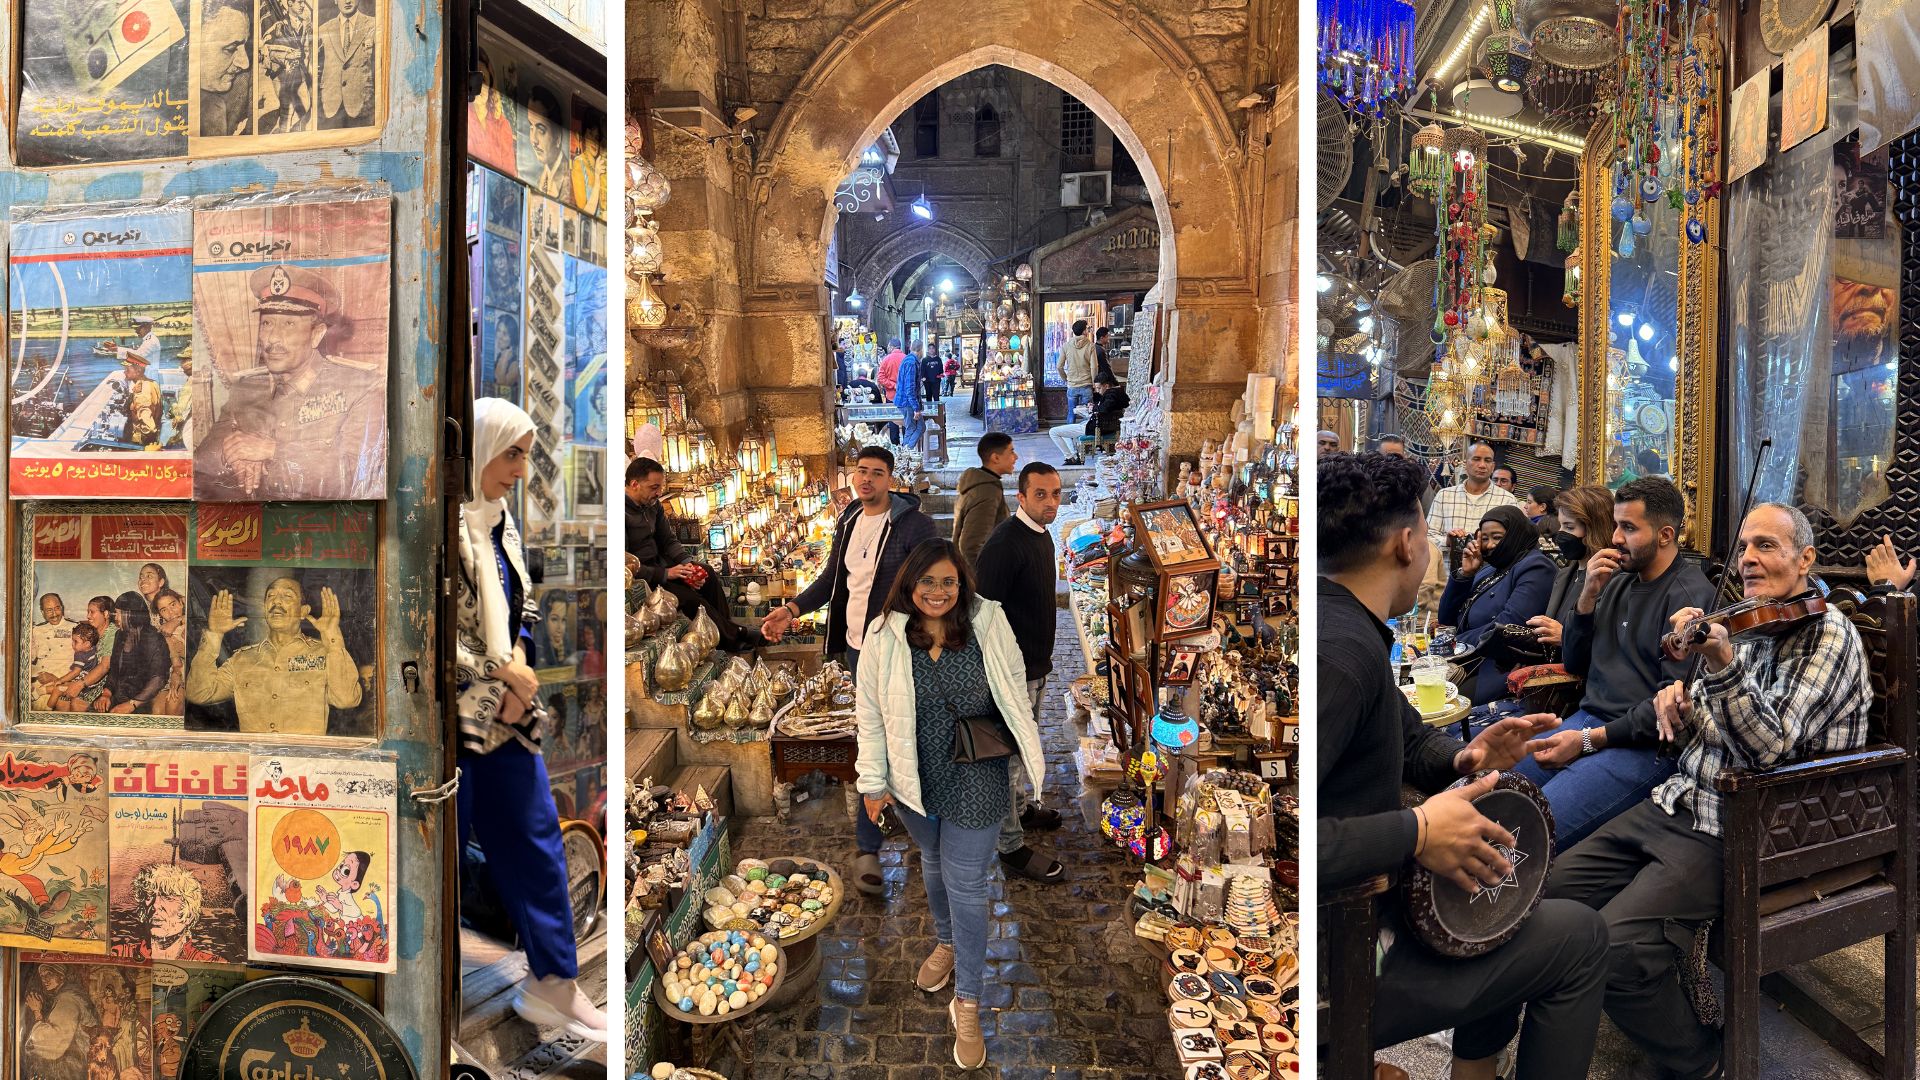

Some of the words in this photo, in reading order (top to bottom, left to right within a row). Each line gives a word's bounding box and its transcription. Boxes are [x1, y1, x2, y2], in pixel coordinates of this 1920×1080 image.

[32, 88, 188, 118] بالديموقراطية
[30, 118, 83, 136] كلمته
[81, 115, 143, 140] الشعب
[145, 115, 188, 137] يقول
[21, 461, 50, 479] يونيو
[51, 462, 63, 477] ٥
[66, 465, 86, 480] يوم
[124, 464, 154, 482] العبور
[147, 529, 179, 542] بطل
[100, 542, 140, 553] القناة
[1292, 727, 1299, 742] 8
[113, 763, 179, 793] تان
[1270, 761, 1278, 777] 5
[181, 764, 248, 795] تان
[256, 776, 329, 801] ماجد
[115, 807, 141, 821] لوجان
[141, 808, 168, 821] ميشيل
[283, 834, 330, 857] ١٩٨٧
[572, 880, 593, 904] WHITE
[247, 1009, 286, 1033] APPOINTMENT
[297, 1008, 311, 1016] THE
[312, 1010, 331, 1024] ROYAL
[332, 1020, 354, 1040] DANISH
